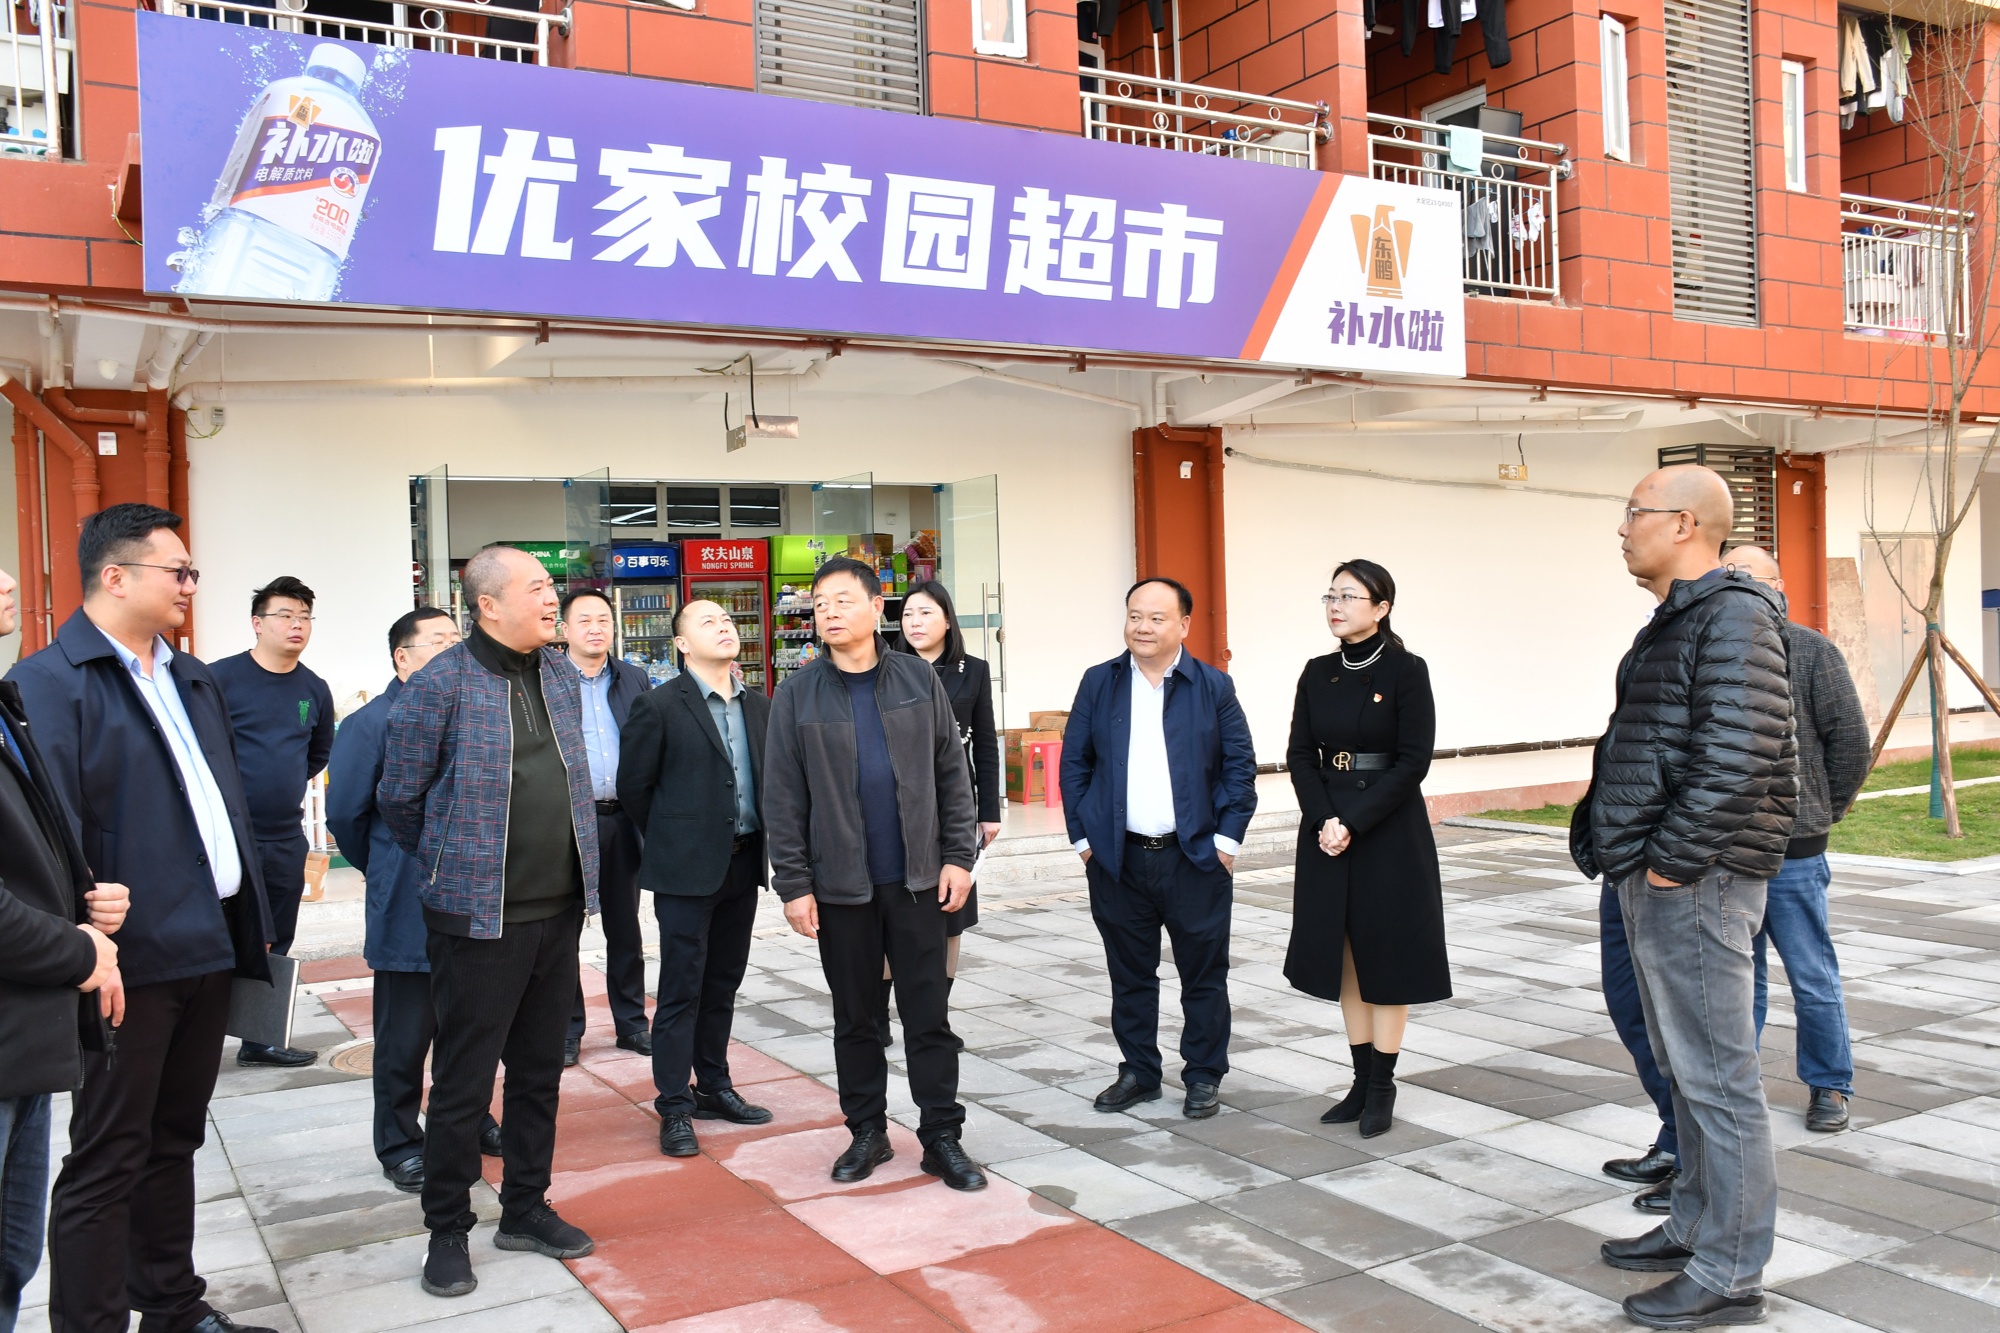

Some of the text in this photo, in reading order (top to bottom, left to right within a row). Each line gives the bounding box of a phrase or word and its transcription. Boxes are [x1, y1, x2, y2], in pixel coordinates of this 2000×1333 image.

[260, 121, 375, 165] 补水啦
[254, 166, 315, 182] 电解质饮料
[433, 125, 1224, 310] 优家校园超市
[1374, 236, 1393, 281] 东鹏
[1327, 300, 1444, 352] 补水啦
[627, 556, 670, 568] 百事可乐
[701, 546, 754, 560] 农夫山泉
[702, 562, 728, 570] NONGFU
